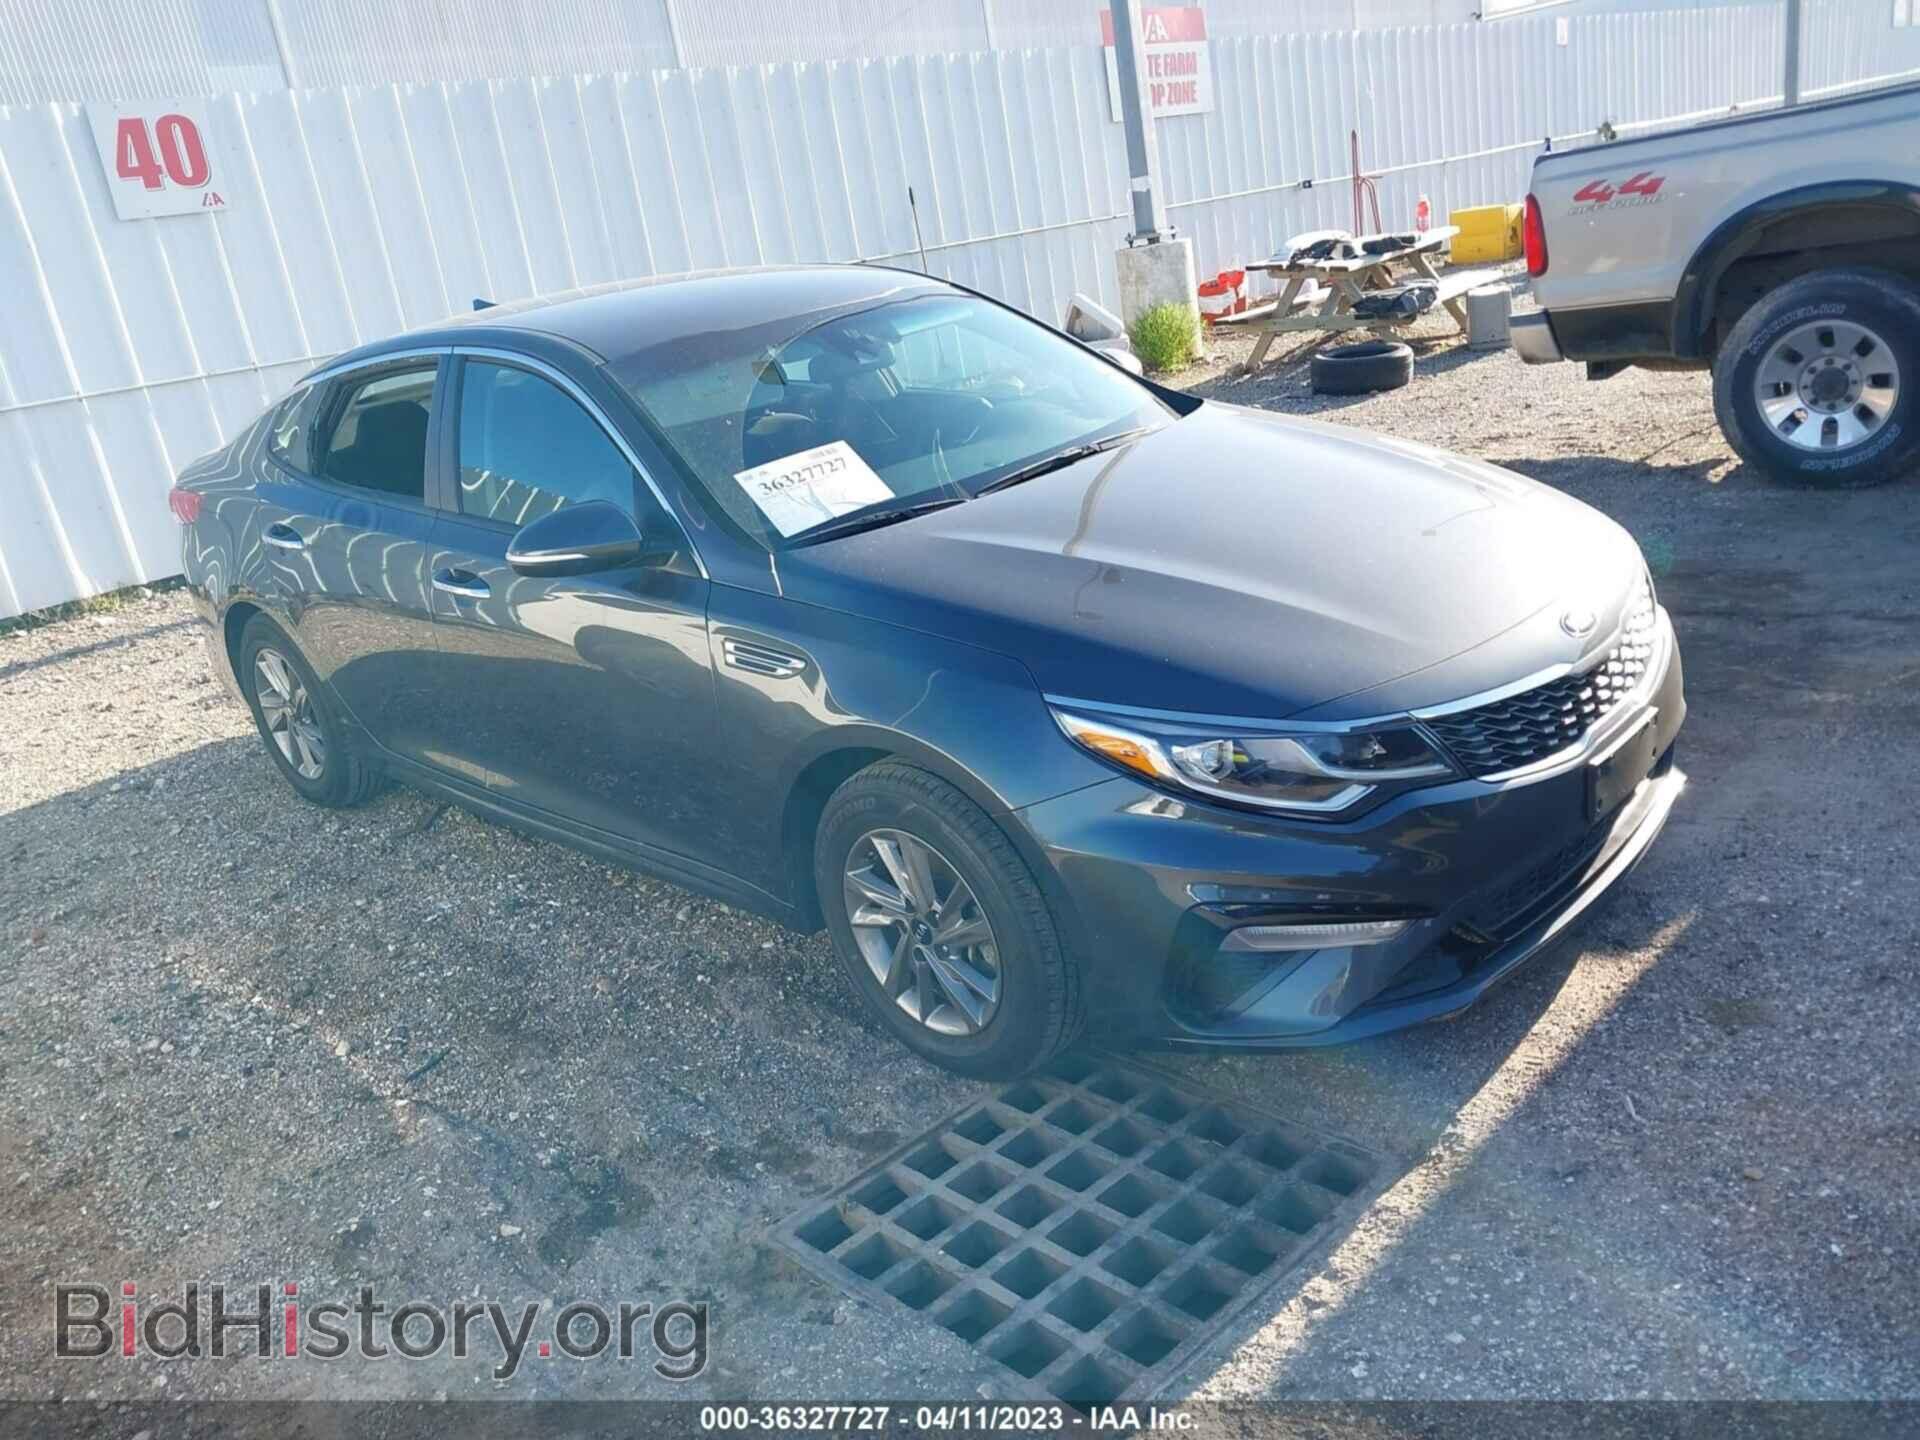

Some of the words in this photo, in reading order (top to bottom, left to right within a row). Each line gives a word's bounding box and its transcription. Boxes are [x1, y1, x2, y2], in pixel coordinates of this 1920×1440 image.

[1163, 51, 1198, 77] FARM
[1167, 80, 1198, 106] ZONE
[116, 113, 211, 191] 40
[759, 457, 847, 495] 36327727
